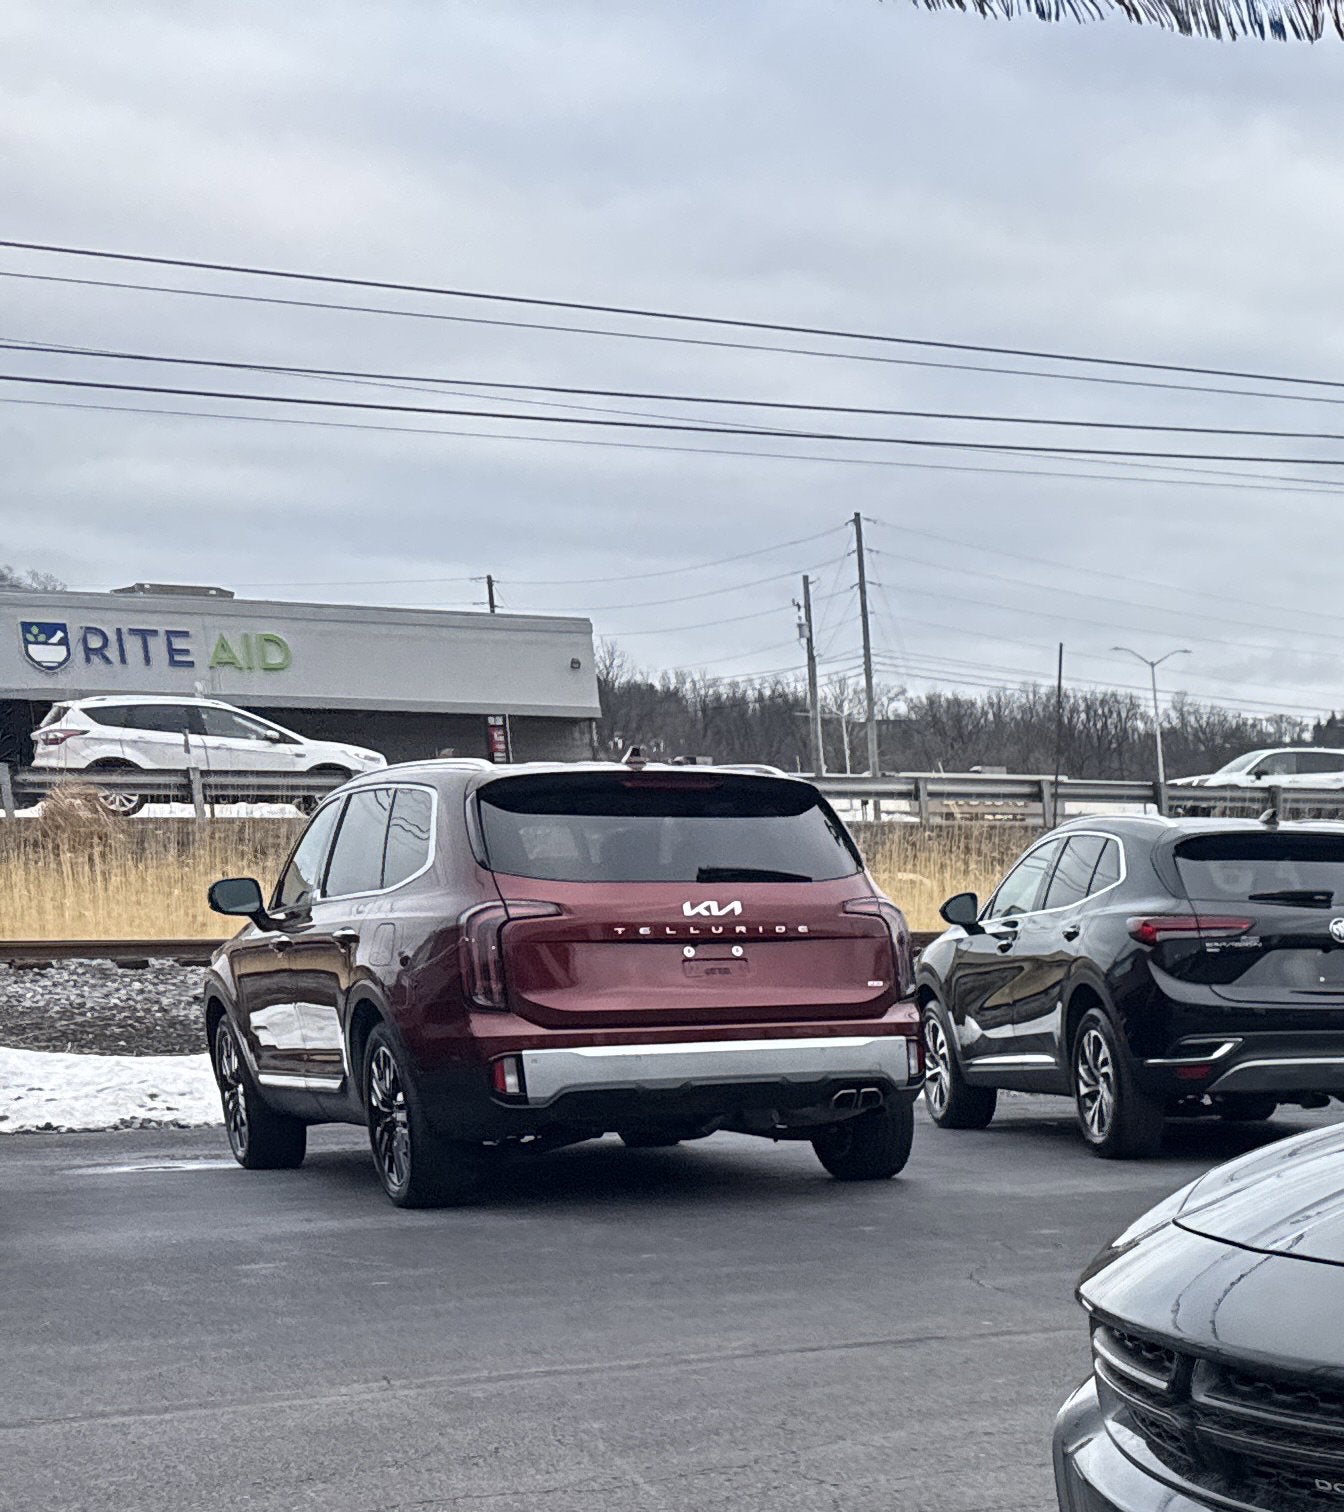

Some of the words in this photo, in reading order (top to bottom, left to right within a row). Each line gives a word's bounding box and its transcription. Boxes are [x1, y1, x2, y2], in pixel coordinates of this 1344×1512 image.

[82, 626, 195, 668] RITE
[209, 632, 292, 670] AID
[614, 925, 809, 935] TELLURIDE
